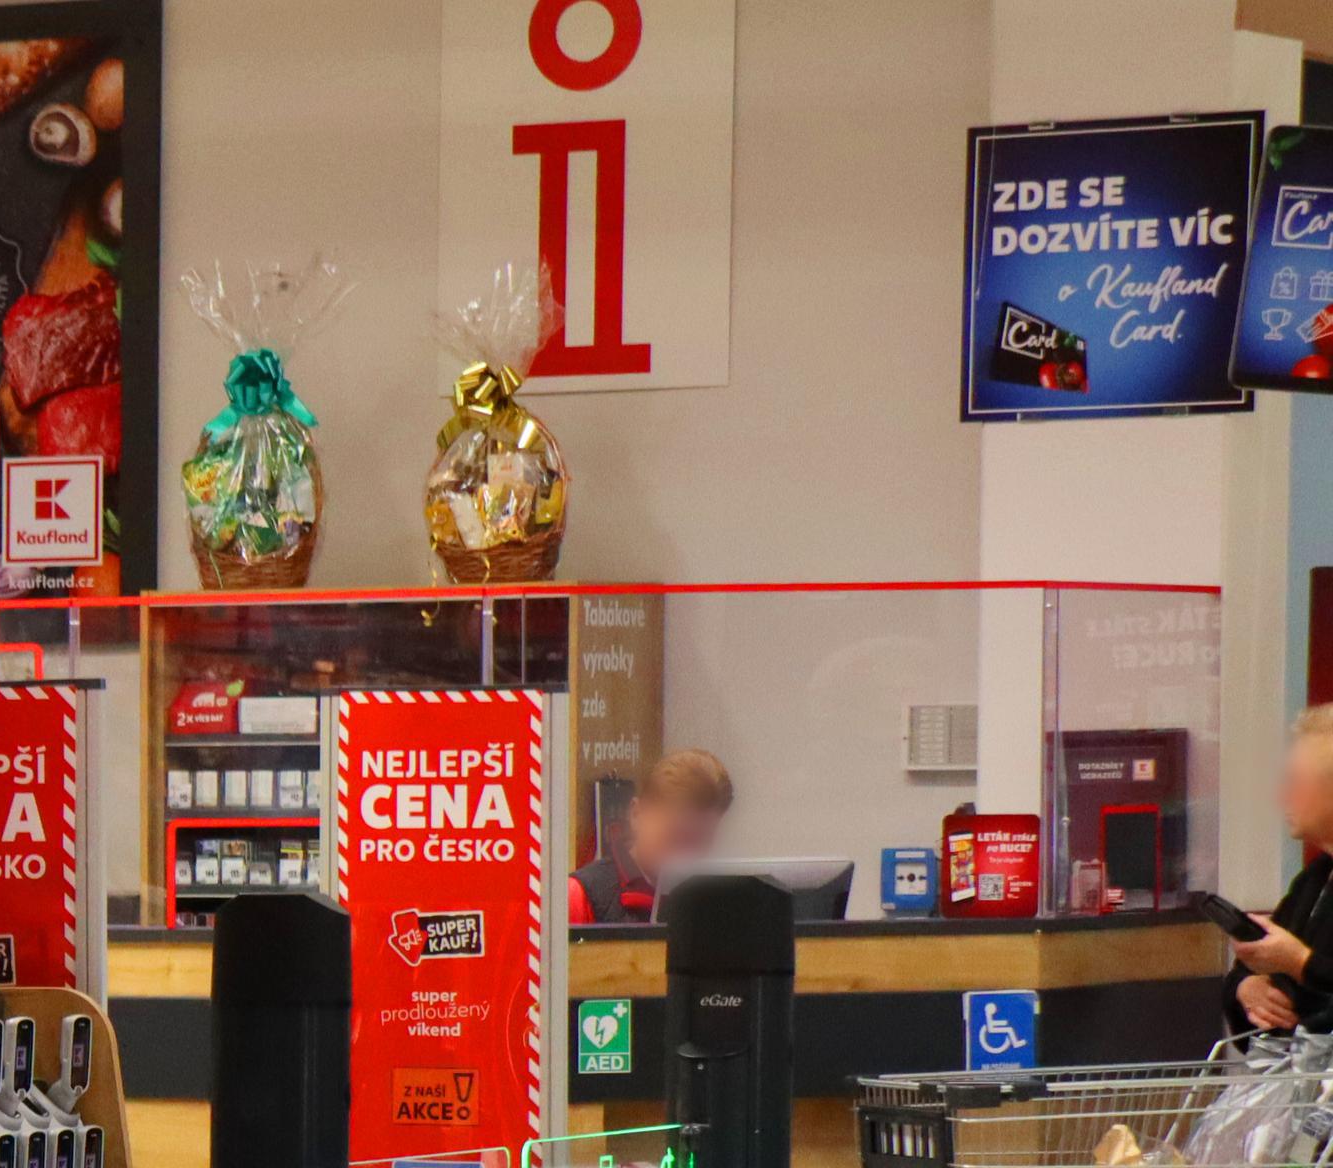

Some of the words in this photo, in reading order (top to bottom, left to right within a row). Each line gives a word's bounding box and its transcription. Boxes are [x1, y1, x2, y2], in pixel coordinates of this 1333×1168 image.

[993, 179, 1067, 212] ZDE
[1079, 176, 1125, 207] SE
[992, 213, 1159, 256] DOZVÍTE
[1169, 207, 1233, 246] VÍC
[1058, 284, 1077, 301] o
[1087, 262, 1229, 313] Kaufland
[1008, 324, 1058, 350] Card
[16, 529, 89, 545] Kaufland
[9, 574, 95, 591] kaufland.cz
[583, 645, 634, 678] výrobky
[583, 691, 606, 718] zde
[361, 743, 515, 778] NEJLEPŠÍ
[360, 784, 514, 829] CENA
[360, 839, 415, 861] PRO
[424, 834, 515, 862] ČESKO
[426, 919, 477, 938] SUPER
[428, 931, 478, 952] KAUF!
[411, 991, 457, 1005] super
[699, 993, 741, 1008] eGate
[381, 1001, 490, 1026] prodloužený
[407, 1021, 461, 1037] víkend
[585, 1056, 624, 1071] AED
[404, 1086, 412, 1097] Z
[415, 1083, 446, 1097] NAŠÍ
